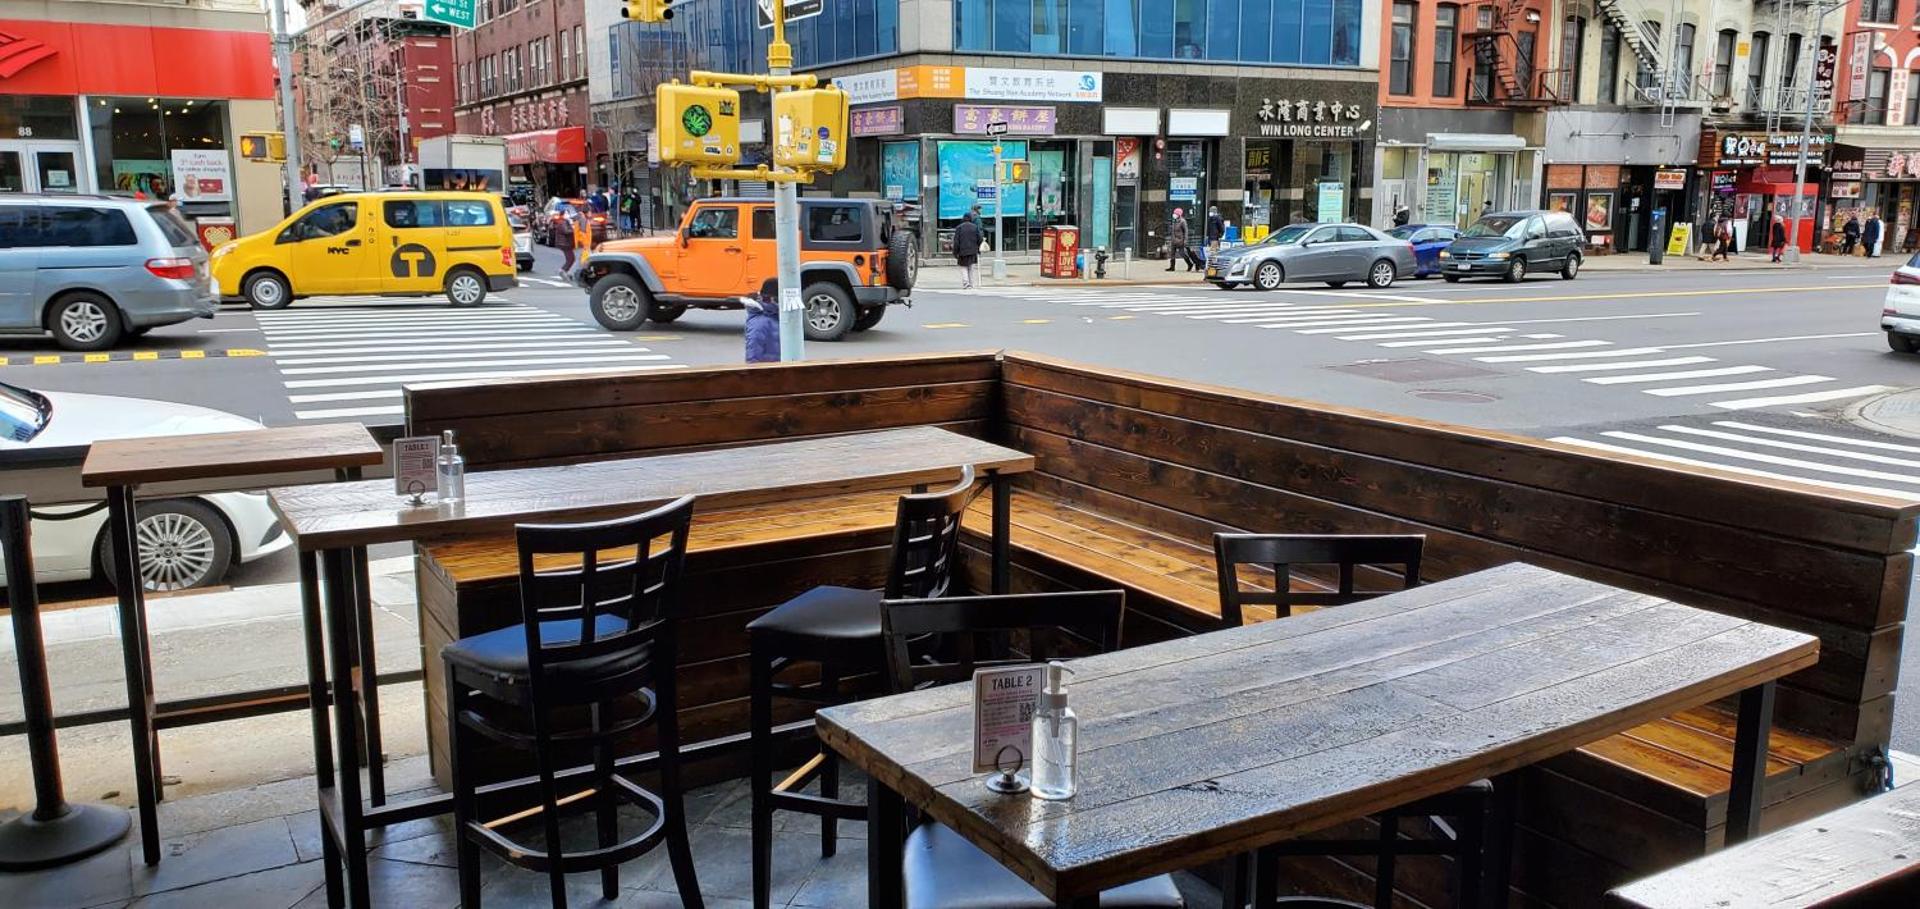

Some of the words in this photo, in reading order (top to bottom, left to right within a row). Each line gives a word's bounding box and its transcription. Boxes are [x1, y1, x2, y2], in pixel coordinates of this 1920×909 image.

[449, 7, 470, 20] WEST
[1259, 98, 1361, 121] 永隆商業中心
[18, 126, 33, 137] 88
[1260, 124, 1281, 136] WIN
[1283, 124, 1312, 137] LONG
[1314, 125, 1355, 137] CENTER
[327, 247, 349, 255] NYC
[992, 676, 1024, 690] TABLE
[1026, 675, 1033, 686] 2
